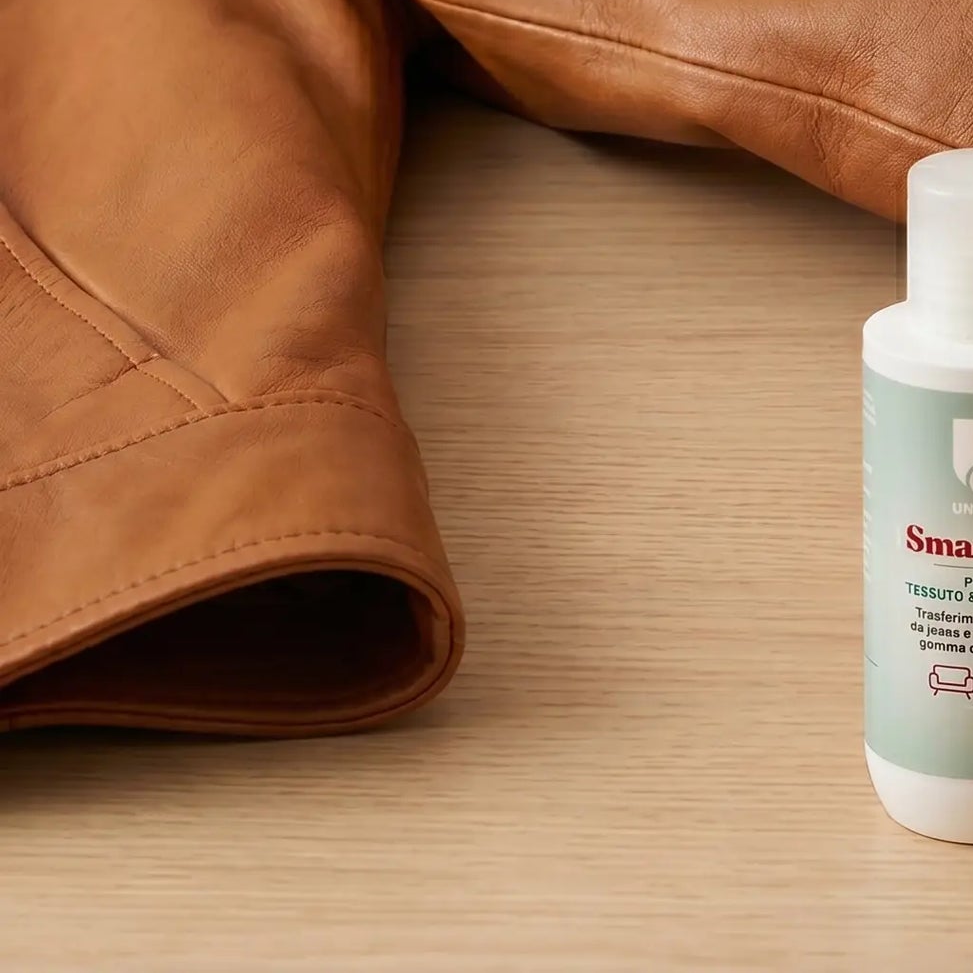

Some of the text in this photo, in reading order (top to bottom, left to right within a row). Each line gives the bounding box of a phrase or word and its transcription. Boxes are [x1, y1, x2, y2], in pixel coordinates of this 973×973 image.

[905, 582, 964, 602] TESSUTO
[910, 621, 924, 633] da
[963, 630, 971, 639] e
[919, 639, 966, 654] gomma
